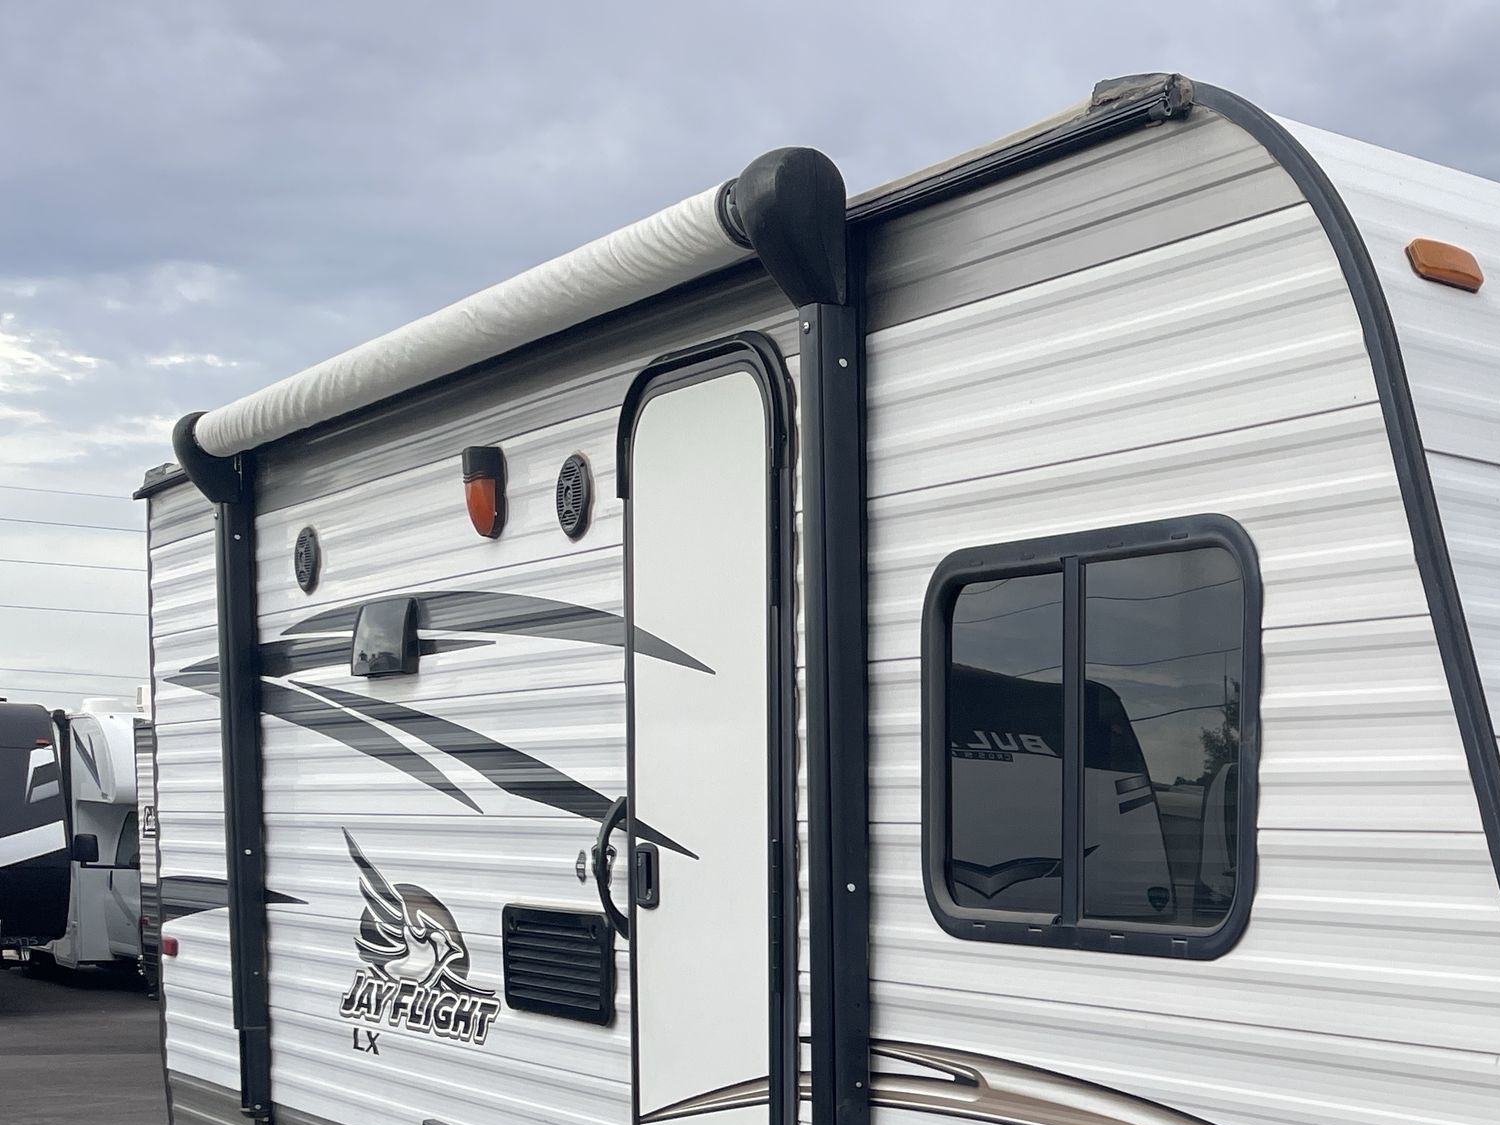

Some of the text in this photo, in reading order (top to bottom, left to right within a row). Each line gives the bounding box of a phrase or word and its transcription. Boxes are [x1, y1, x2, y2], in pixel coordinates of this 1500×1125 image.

[340, 970, 500, 1045] JAY FLIGHT
[353, 1028, 380, 1055] LX
